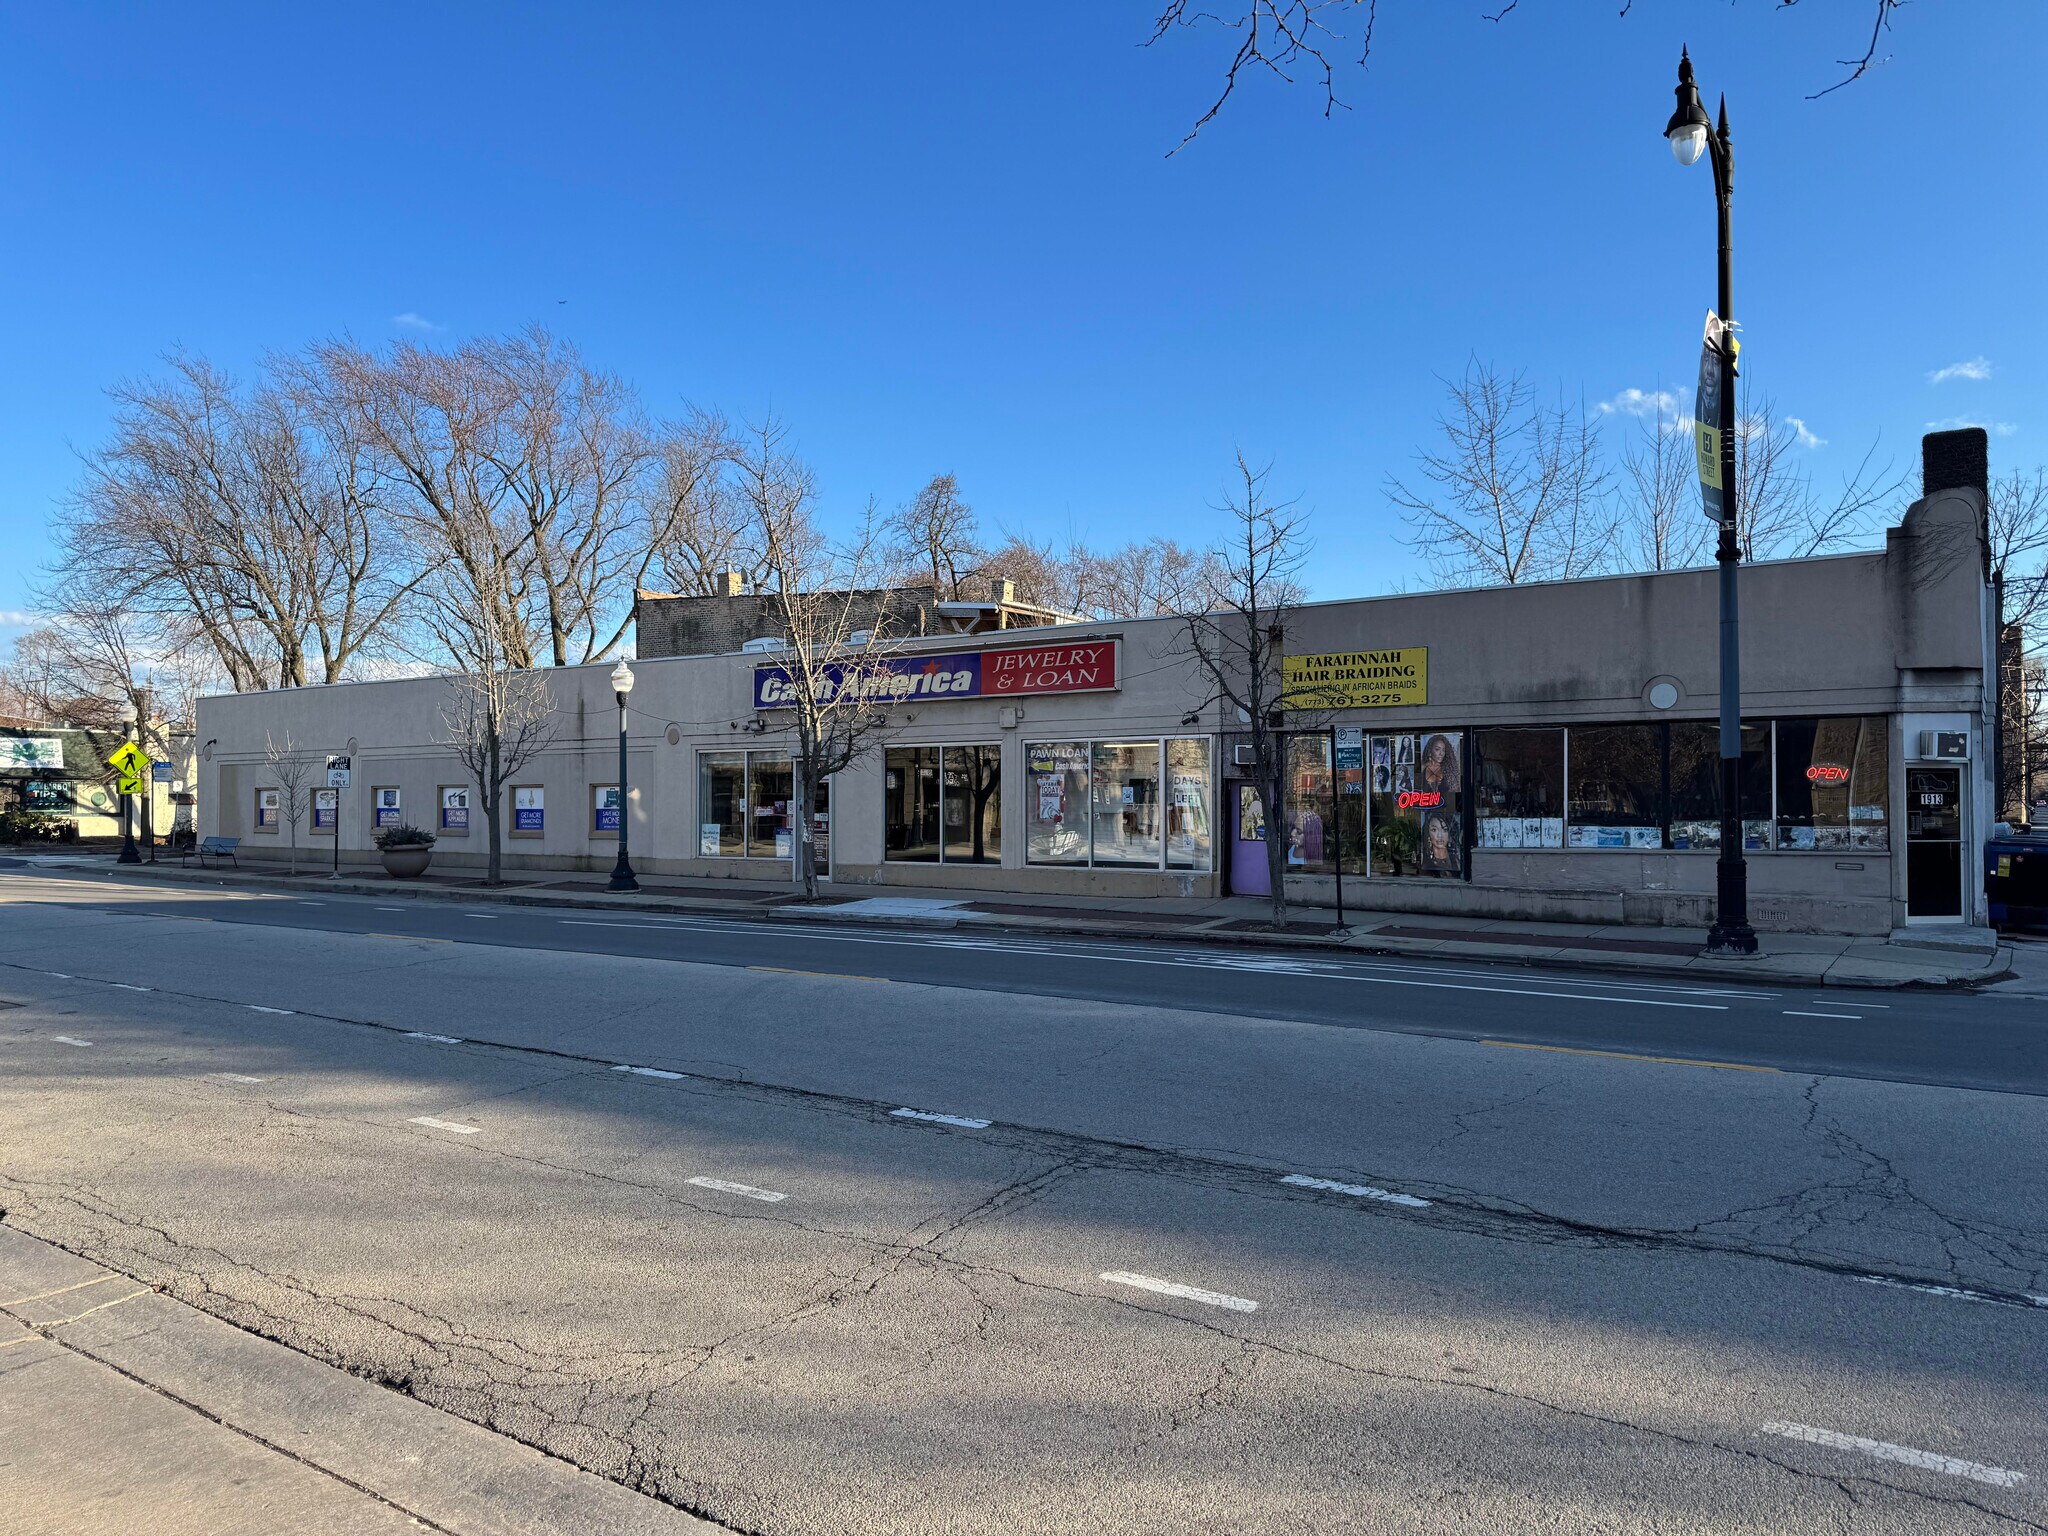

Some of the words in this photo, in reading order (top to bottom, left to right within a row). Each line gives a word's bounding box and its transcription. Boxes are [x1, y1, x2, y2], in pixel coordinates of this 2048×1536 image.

[1700, 451, 1716, 467] HOWARD
[1702, 463, 1715, 479] STREET
[992, 647, 1105, 673] JEWELRY
[1305, 651, 1401, 668] FARAFINNAH
[997, 673, 1015, 689] &
[1022, 667, 1100, 688] LOAN
[1292, 670, 1330, 682] HAIR
[1335, 664, 1415, 680] BRAIDING
[1342, 684, 1350, 692] IN
[1352, 681, 1386, 691] AFRICAN
[1387, 679, 1417, 689] BRAIDS
[1030, 749, 1059, 759] PAWN
[1174, 776, 1202, 785] DAYS
[1806, 767, 1849, 780] OPEN
[1175, 794, 1200, 803] LEFT
[1398, 791, 1441, 809] OPEN
[1921, 794, 1943, 805] 1913
